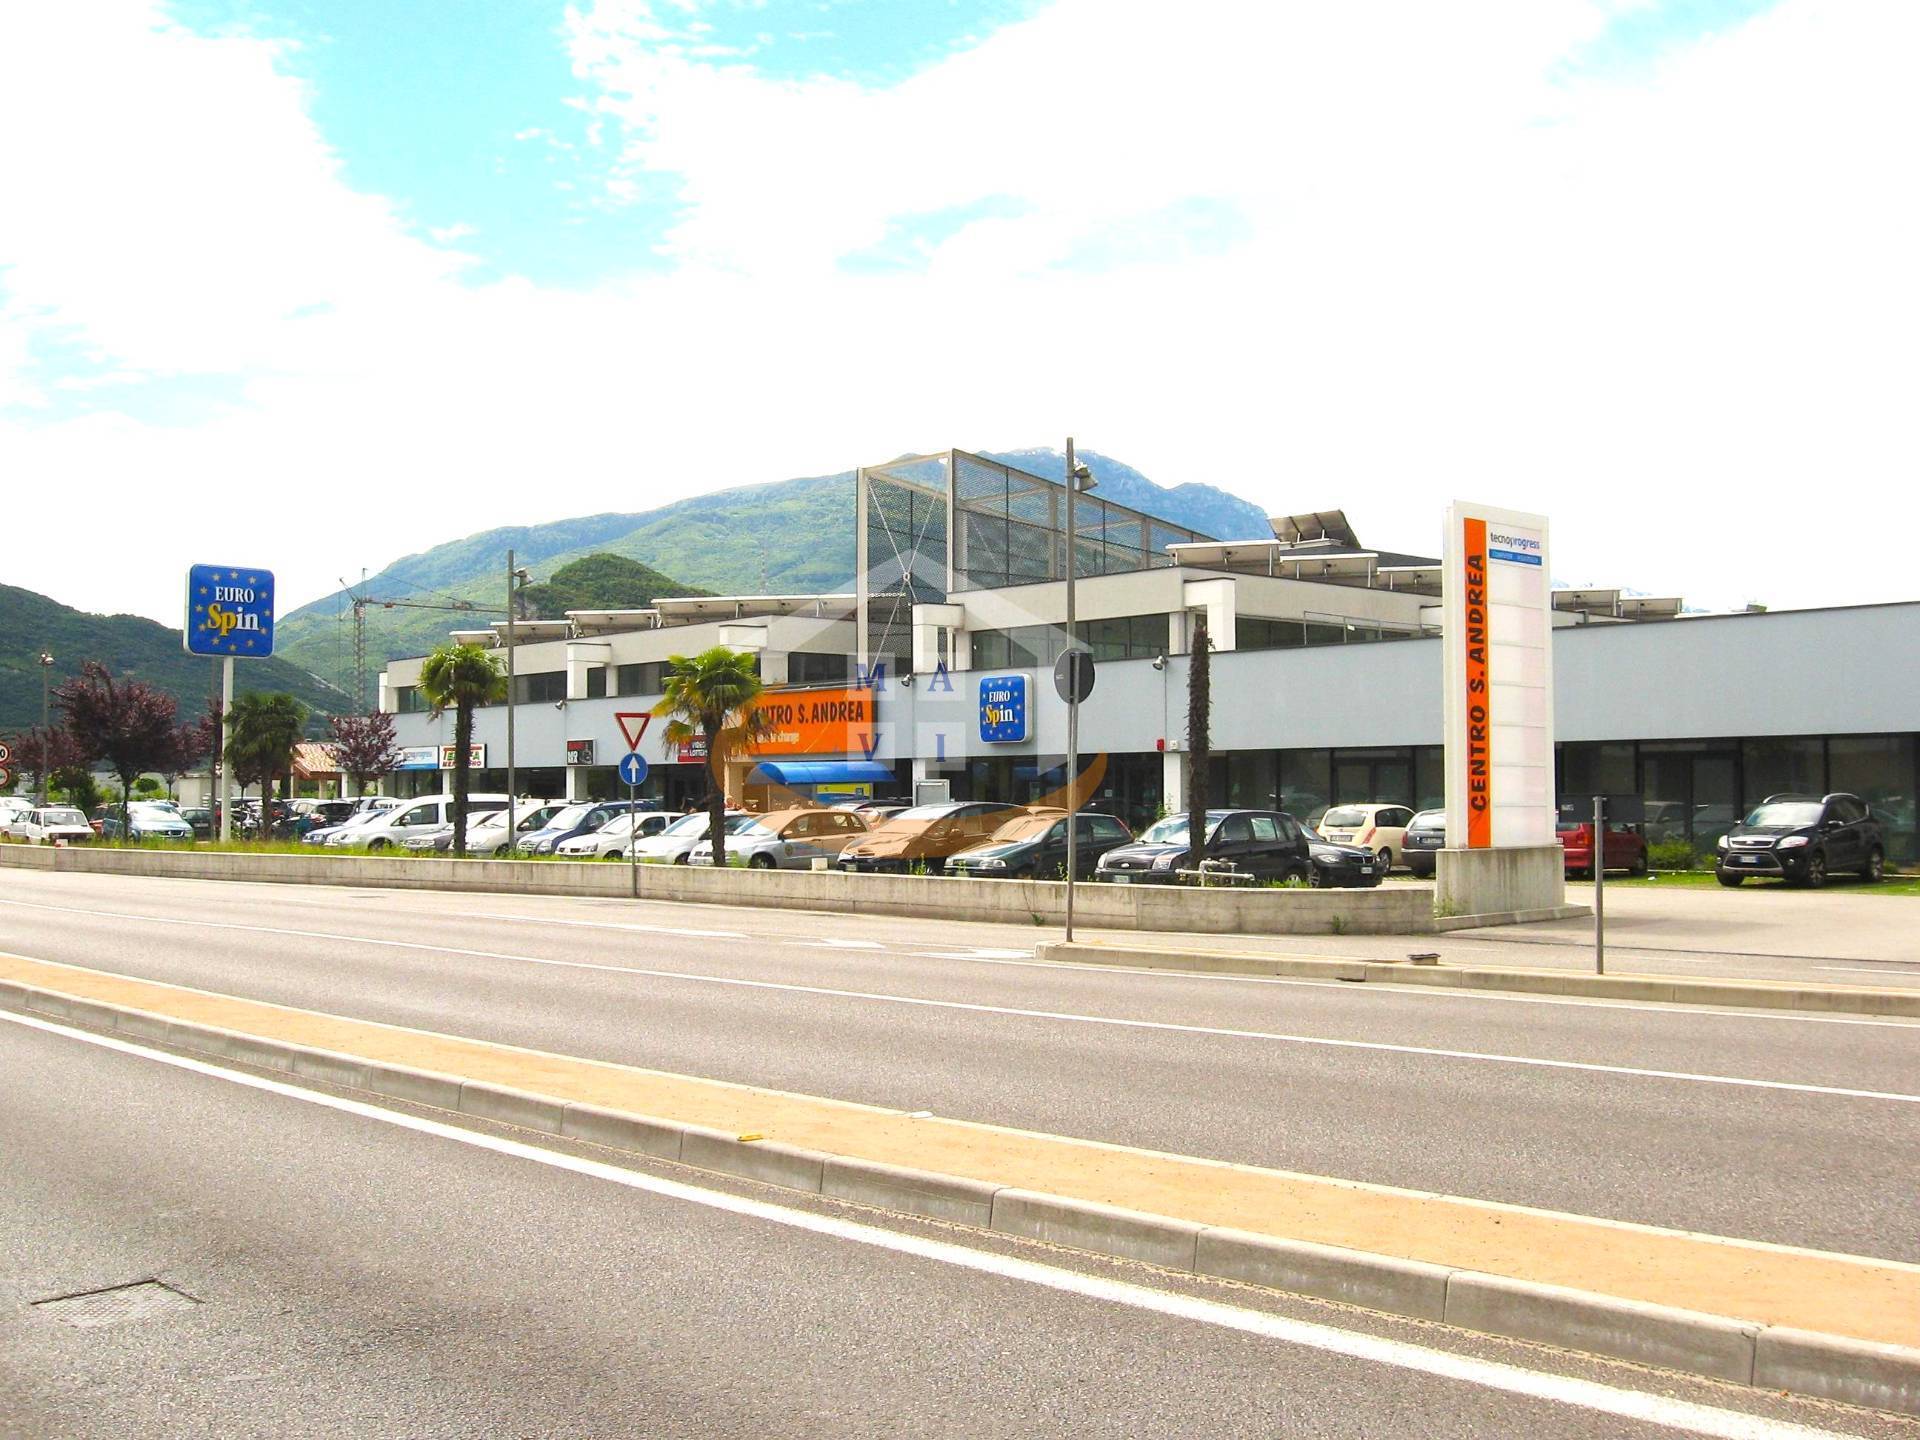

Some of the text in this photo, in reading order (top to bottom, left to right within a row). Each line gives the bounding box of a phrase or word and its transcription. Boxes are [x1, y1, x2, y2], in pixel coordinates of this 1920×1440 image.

[1490, 532, 1540, 550] tecnoprogress
[215, 586, 255, 603] EURO
[207, 603, 259, 636] Spin
[1468, 555, 1487, 811] CENTRO S. ANDREA
[988, 690, 1011, 703] EURO
[798, 703, 809, 724] S.
[811, 701, 864, 724] ANDREA
[986, 704, 1014, 727] Spin
